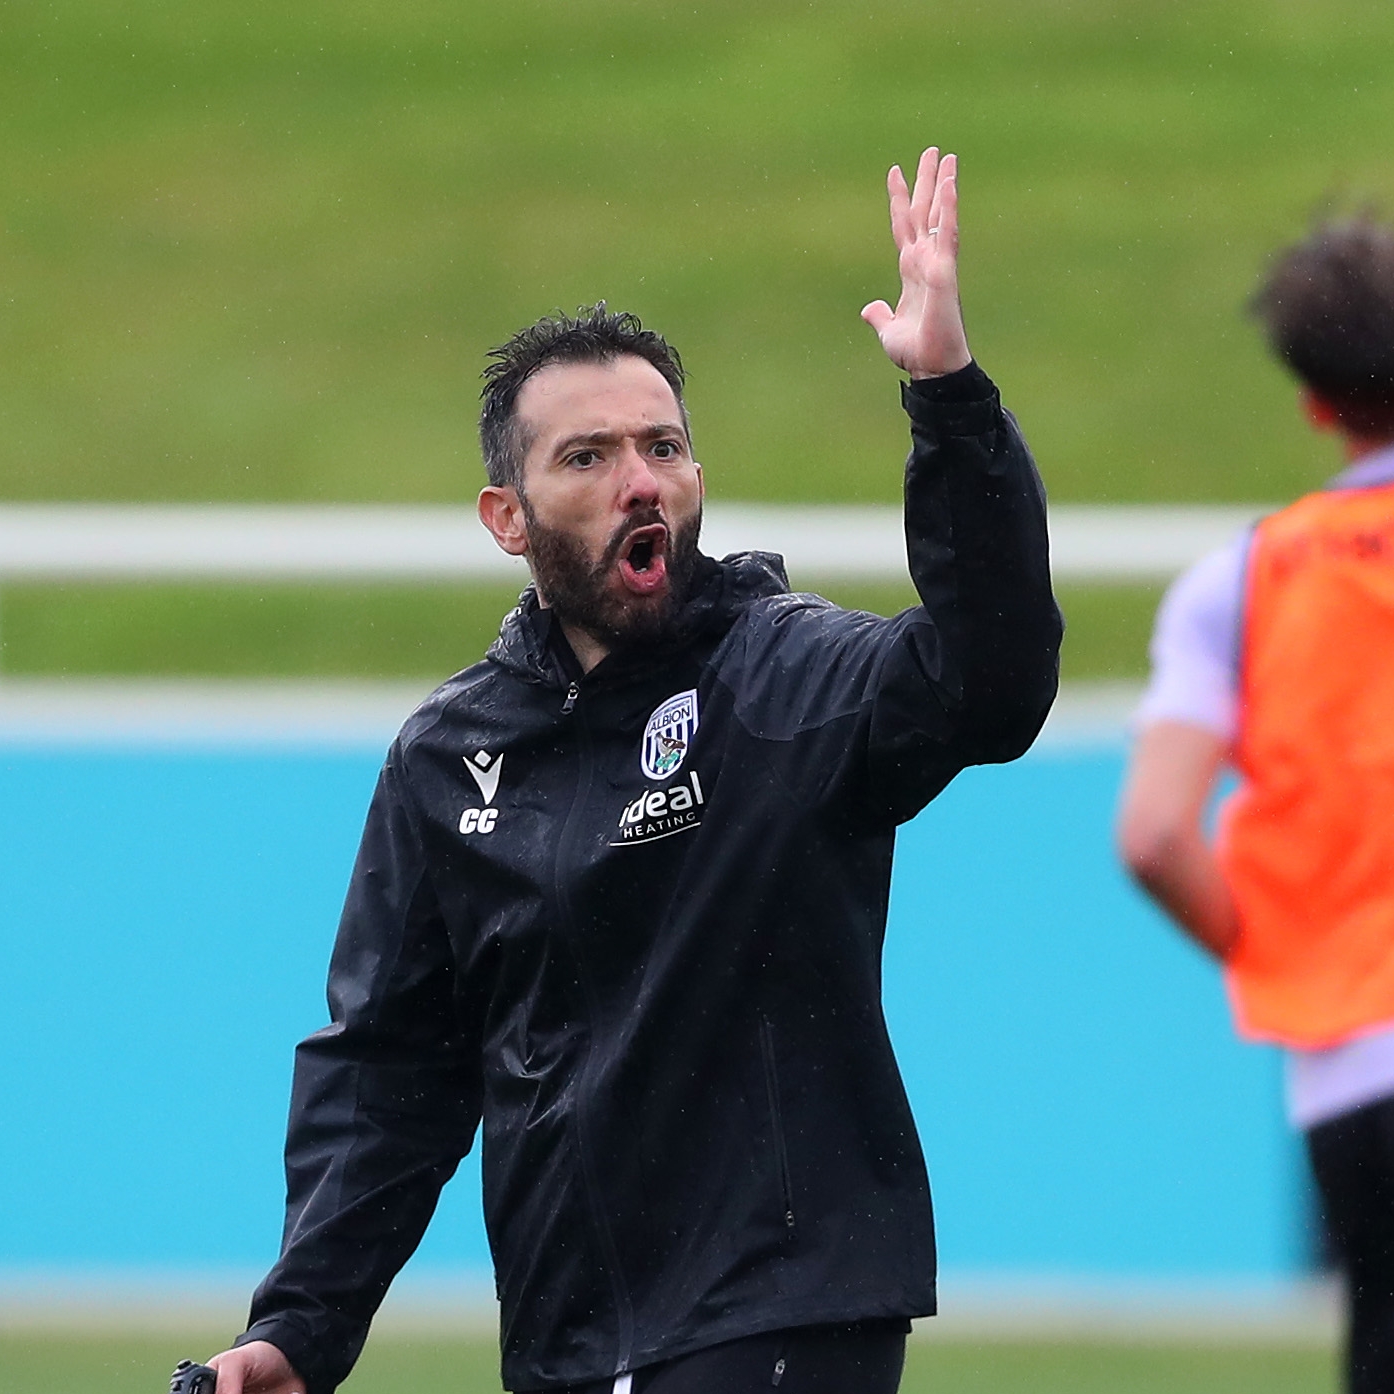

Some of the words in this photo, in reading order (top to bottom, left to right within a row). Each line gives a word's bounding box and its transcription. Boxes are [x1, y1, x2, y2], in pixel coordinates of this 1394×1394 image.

[649, 704, 691, 732] ALBION
[618, 770, 704, 828] ideal
[459, 808, 499, 835] CC
[622, 811, 696, 839] HEATING
